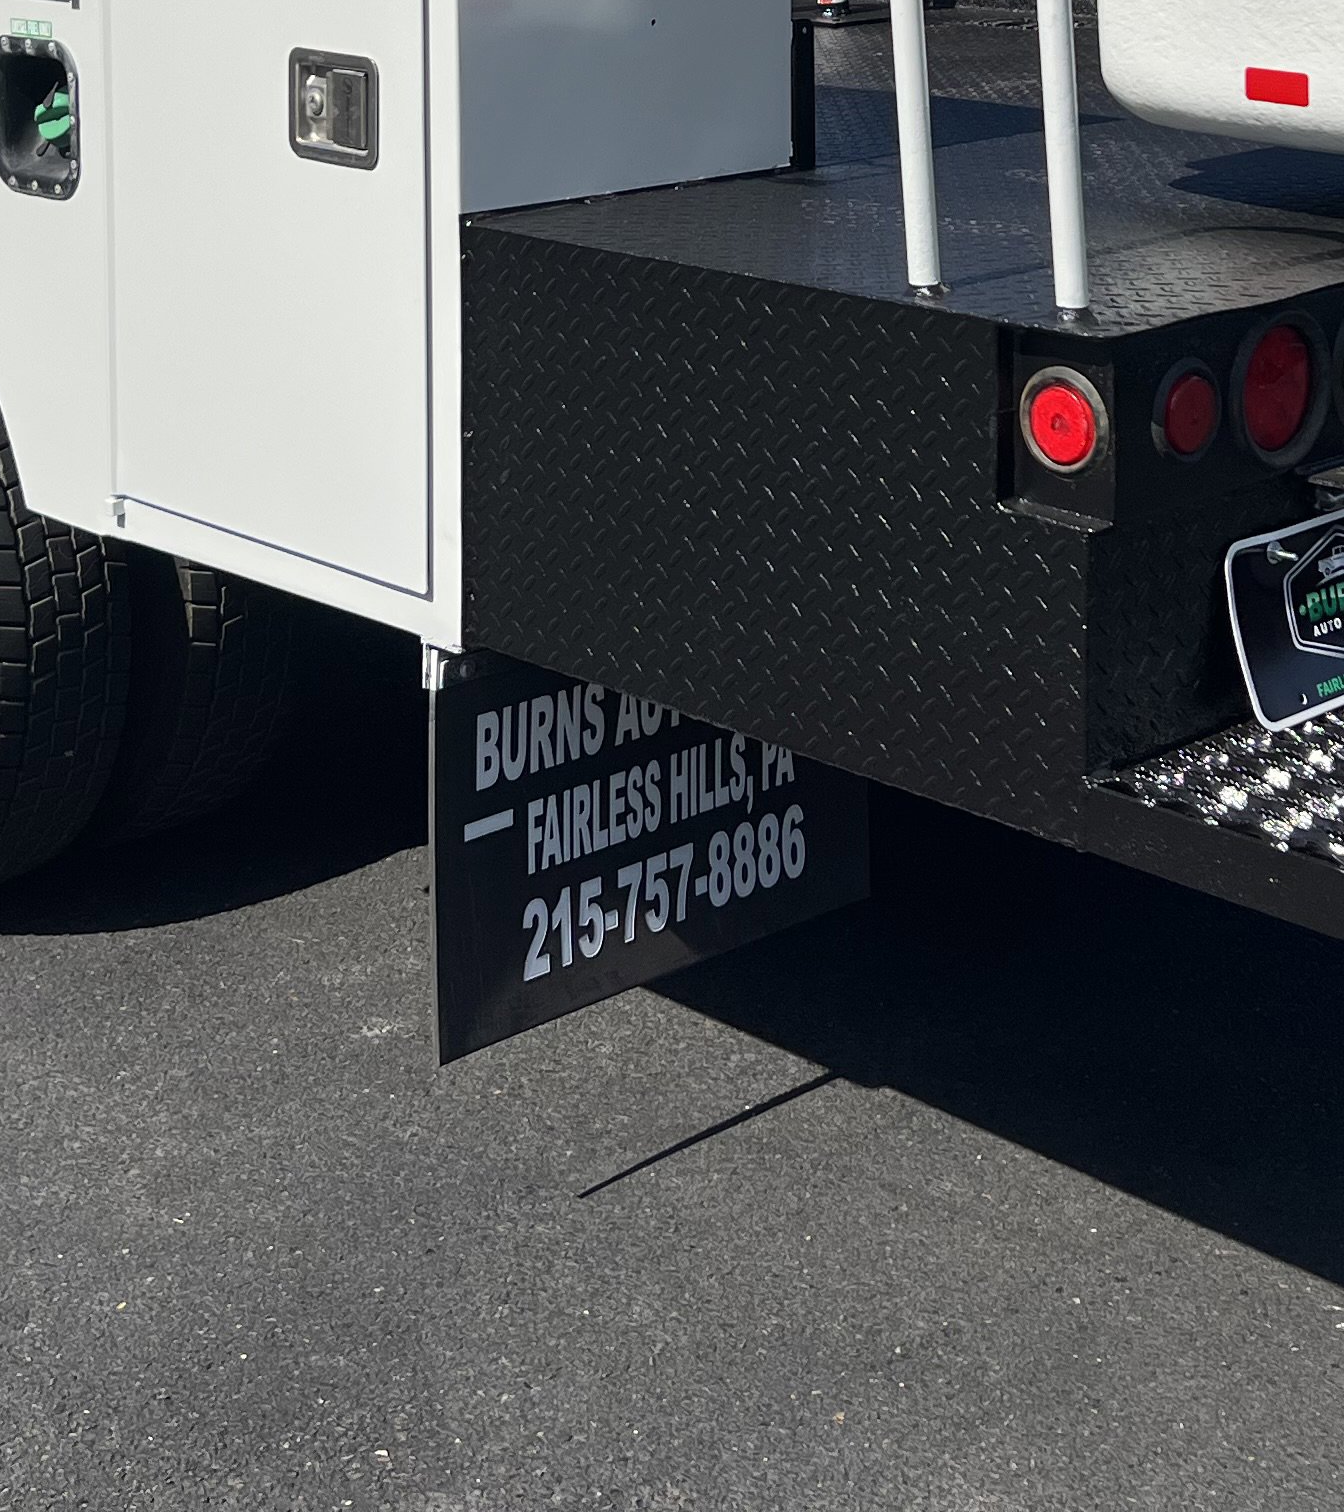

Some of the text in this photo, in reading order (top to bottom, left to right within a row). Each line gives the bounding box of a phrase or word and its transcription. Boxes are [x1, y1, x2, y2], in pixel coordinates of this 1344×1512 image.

[1313, 617, 1343, 637] AUTO
[475, 683, 605, 792] BURNS
[527, 731, 796, 875] FAIRLESS HILLS, PA
[522, 804, 807, 982] 215-757-8886
